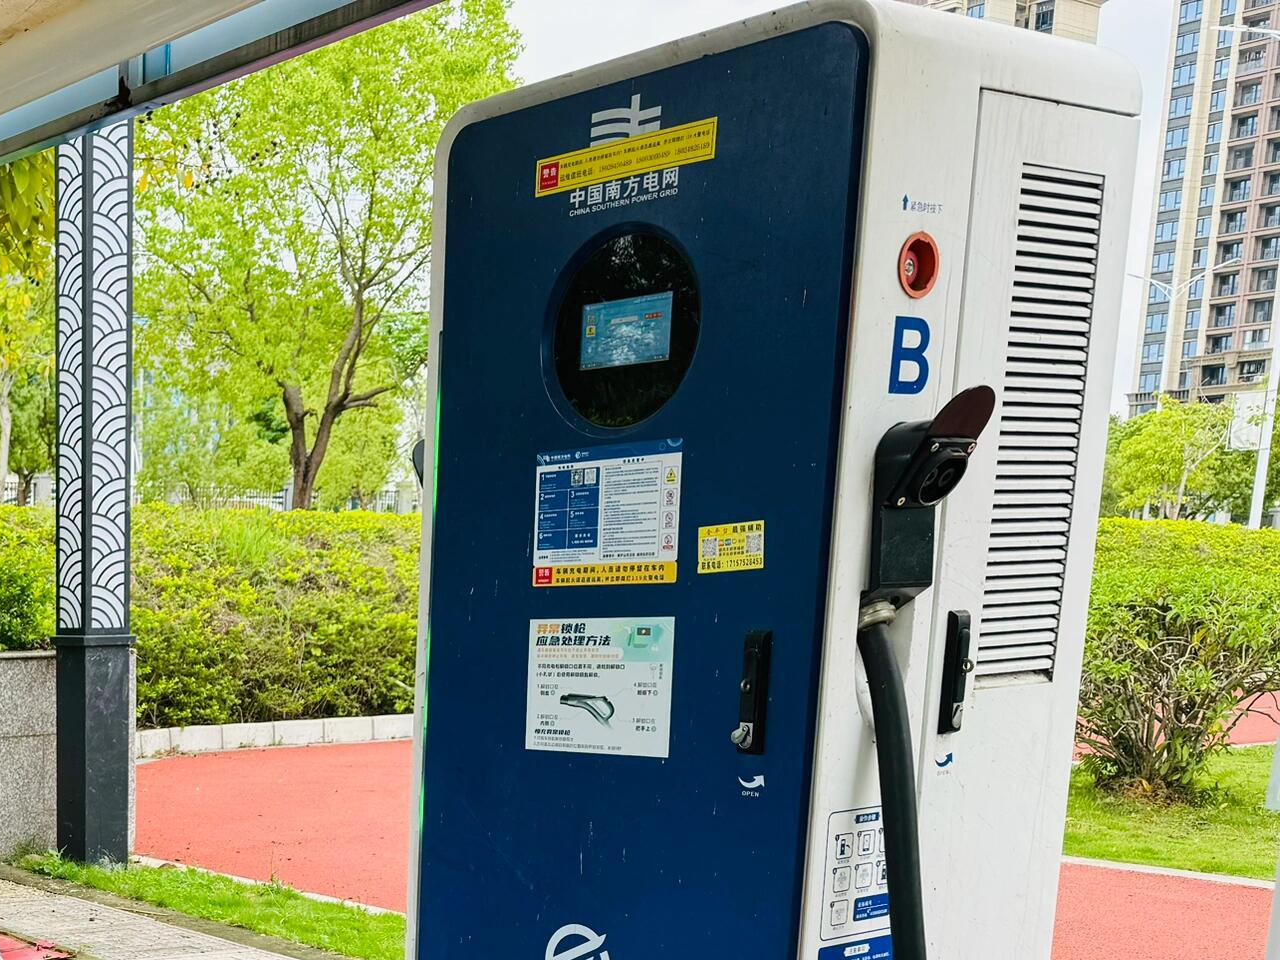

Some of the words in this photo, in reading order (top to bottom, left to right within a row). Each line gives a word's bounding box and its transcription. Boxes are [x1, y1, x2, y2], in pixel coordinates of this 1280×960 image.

[569, 207, 590, 217] CHINA
[592, 198, 630, 212] SOUTHERN
[631, 193, 658, 205] POWER
[659, 187, 678, 198] GRID
[570, 167, 679, 209] 中国南方电网
[888, 316, 930, 394] B
[536, 635, 611, 646] 应急处理方法
[741, 790, 760, 798] OPEN
